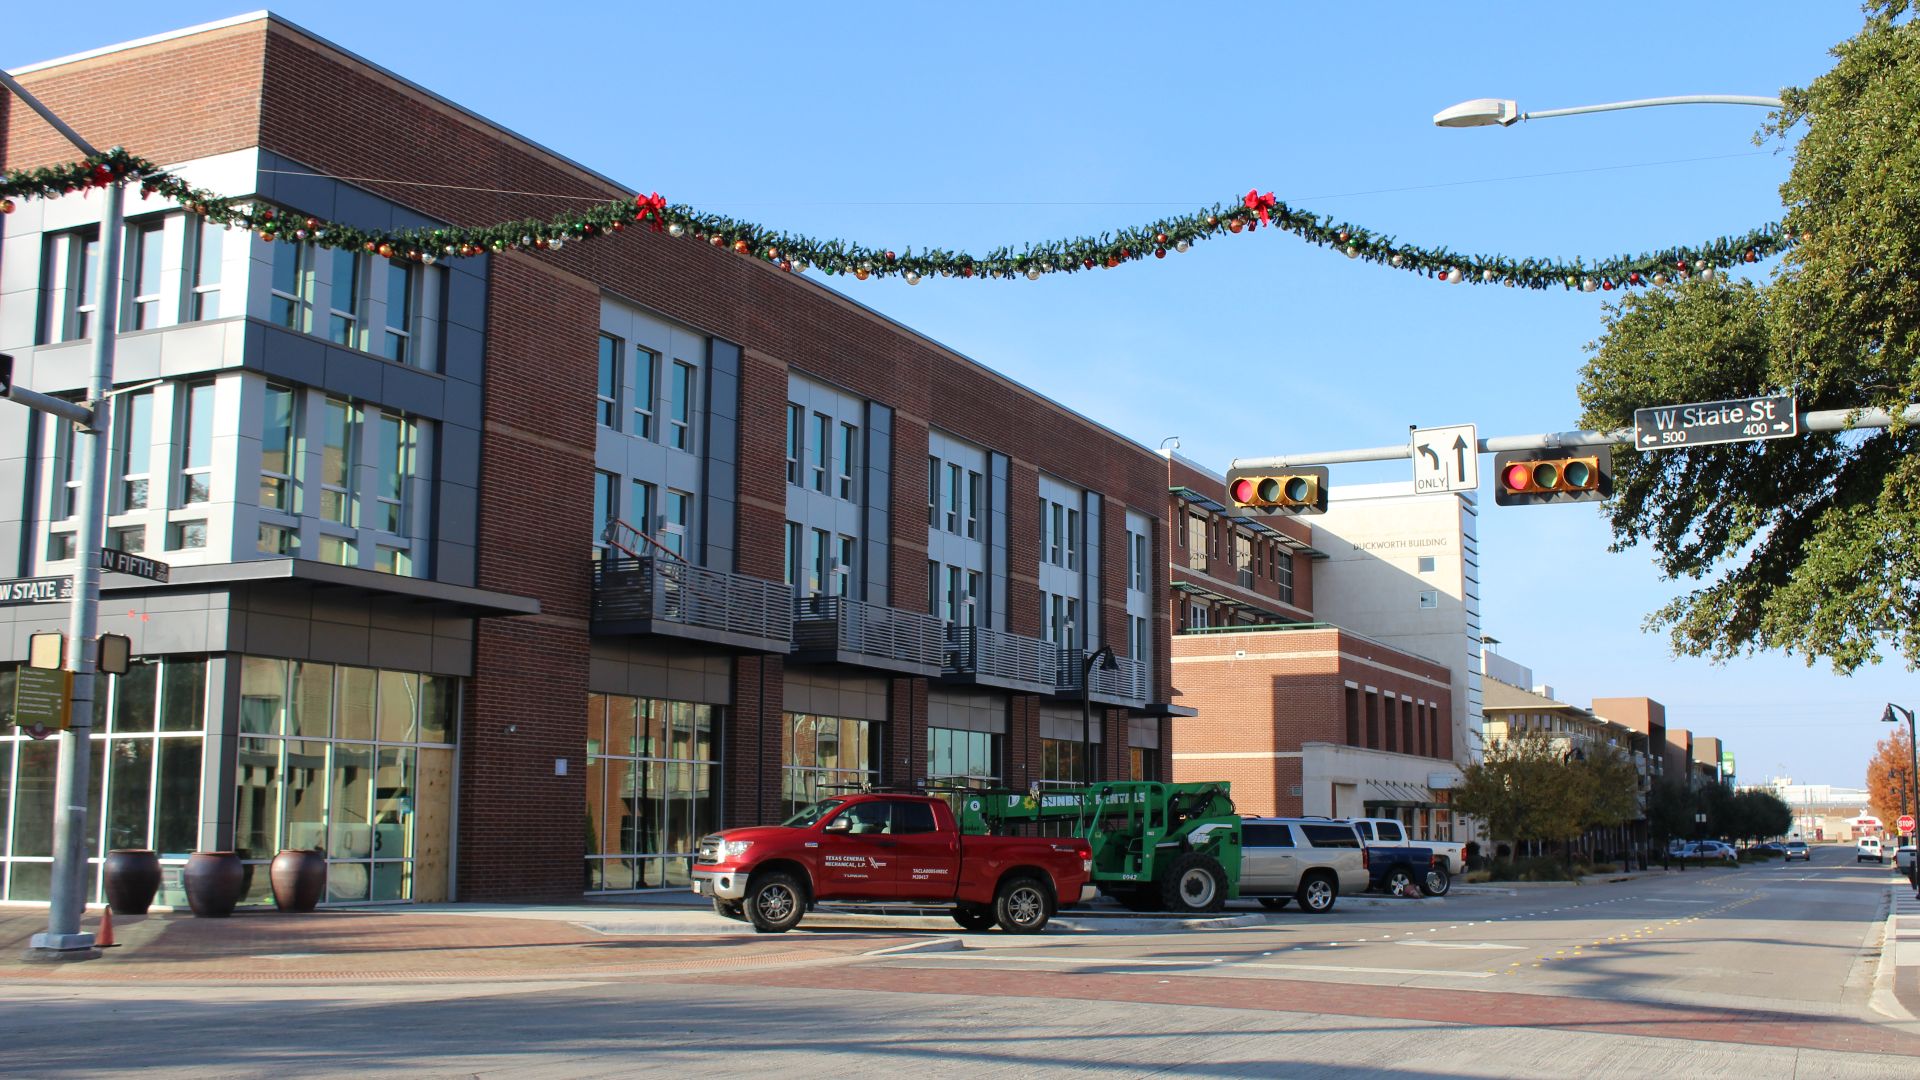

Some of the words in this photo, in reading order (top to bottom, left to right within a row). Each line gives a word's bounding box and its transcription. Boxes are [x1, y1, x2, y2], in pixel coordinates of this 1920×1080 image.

[1654, 409, 1676, 430] W
[1684, 405, 1744, 428] State
[1751, 400, 1775, 422] St
[1662, 430, 1686, 443] 500
[1743, 422, 1768, 435] 400
[1418, 477, 1446, 489] ONLY
[1353, 540, 1407, 550] DUCKWORTH
[1408, 537, 1447, 548] BUILDING
[103, 550, 114, 568] N
[118, 553, 154, 577] FIFTH
[0, 584, 12, 601] W
[12, 581, 56, 600] STATE
[1898, 820, 1914, 828] STOP
